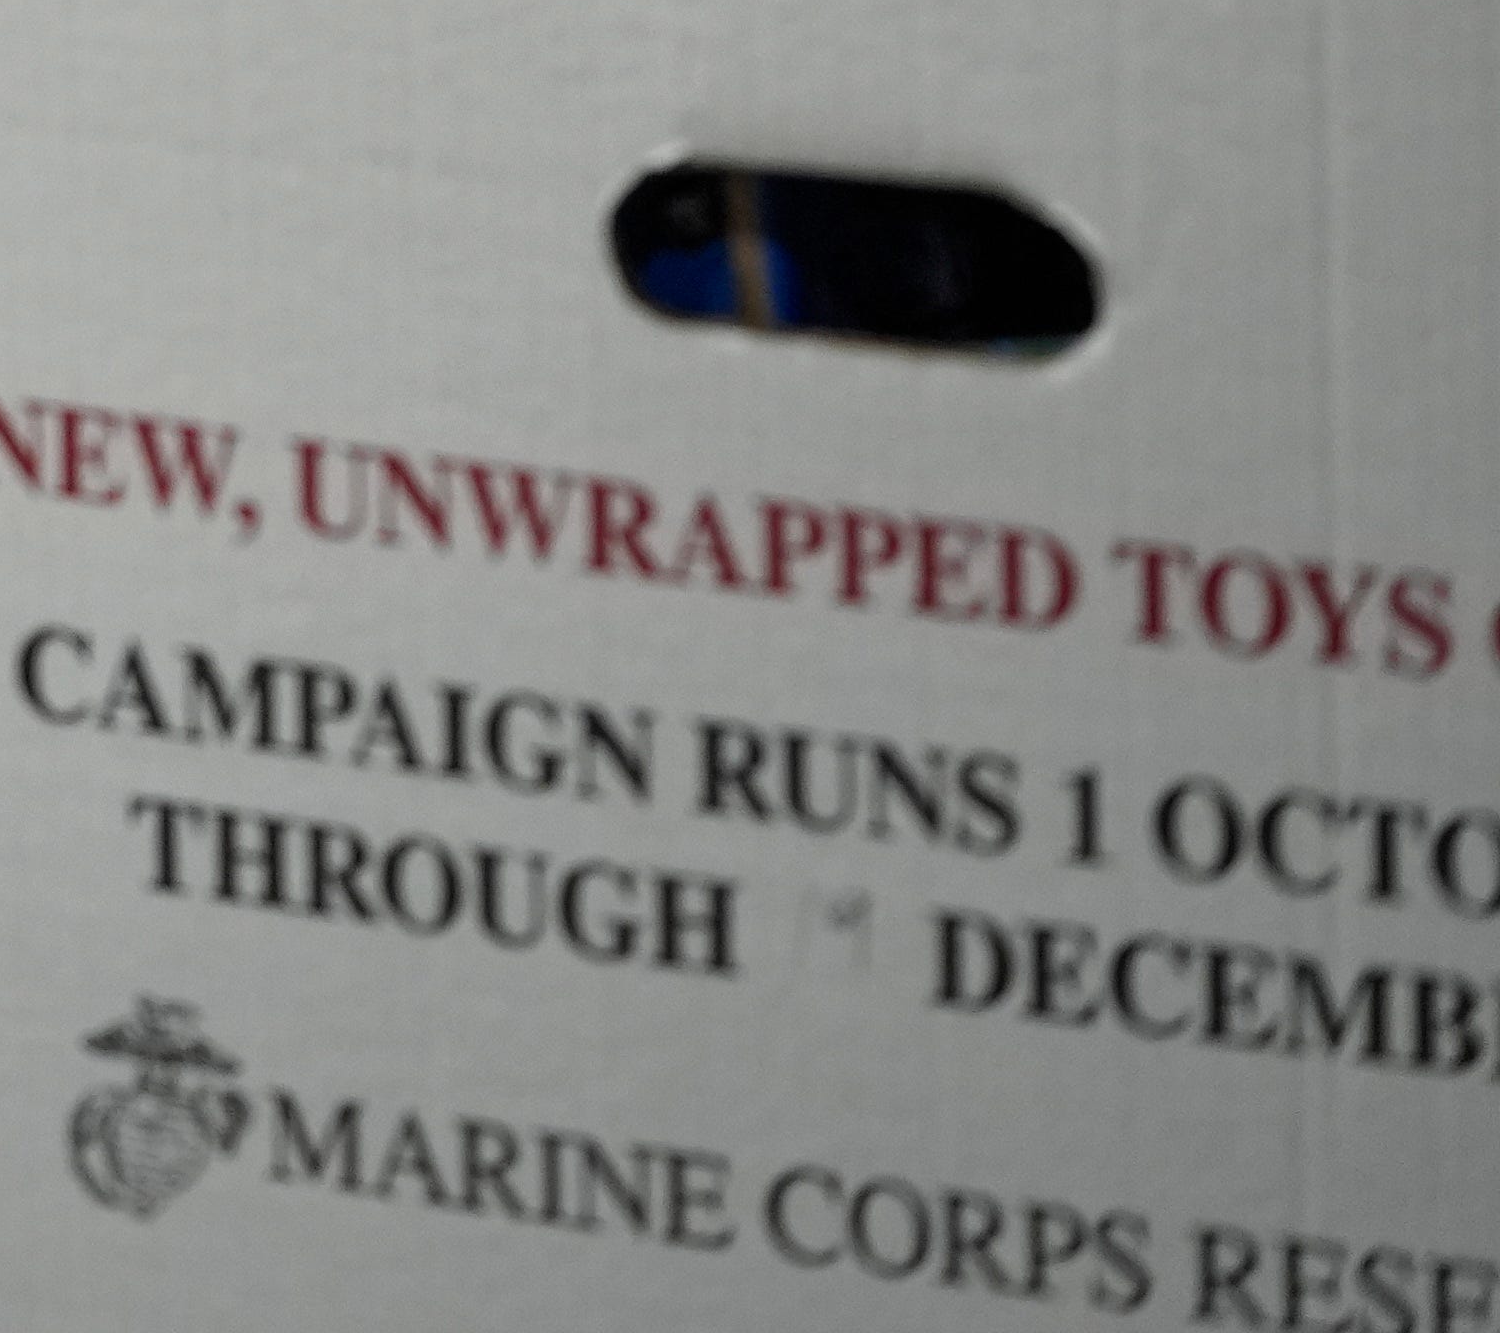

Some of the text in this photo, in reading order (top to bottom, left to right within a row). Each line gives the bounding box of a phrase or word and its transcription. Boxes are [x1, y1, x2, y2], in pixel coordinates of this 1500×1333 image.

[293, 434, 1077, 631] UNWRAPPED
[1110, 539, 1457, 680] TOYS
[16, 624, 1500, 923] CAMPAIGN RUNS 1 OCTO
[126, 792, 1500, 1088] THROUGH DECEMB
[265, 1088, 1500, 1333] MARINE CORPS RESE
